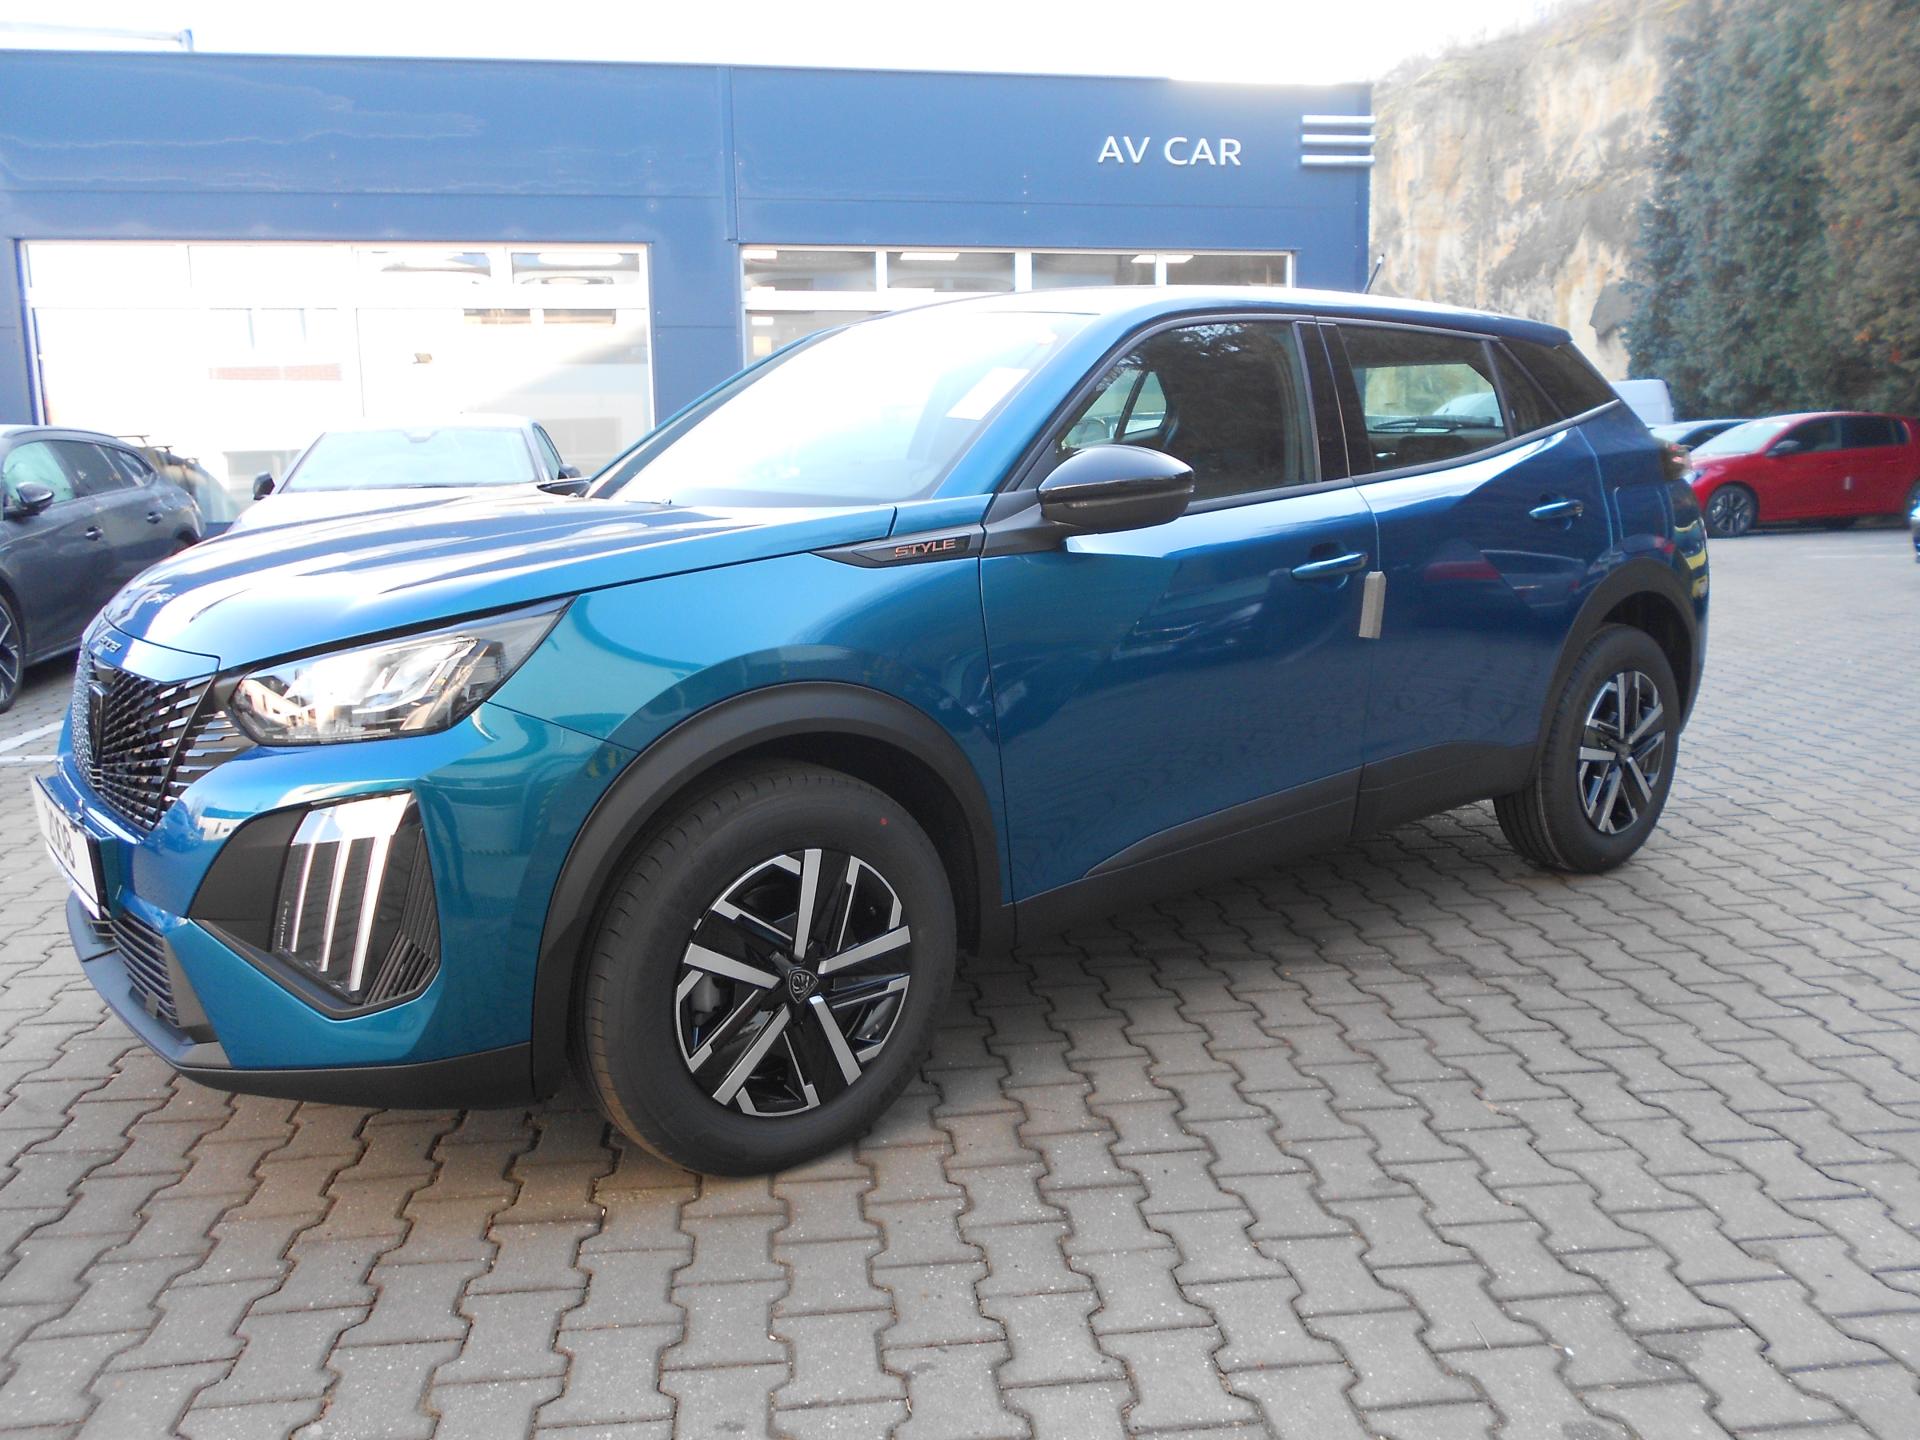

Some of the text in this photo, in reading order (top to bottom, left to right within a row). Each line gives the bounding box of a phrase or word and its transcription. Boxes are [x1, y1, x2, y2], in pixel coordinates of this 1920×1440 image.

[1097, 135, 1242, 166] AV CAR
[895, 538, 957, 557] STYLE
